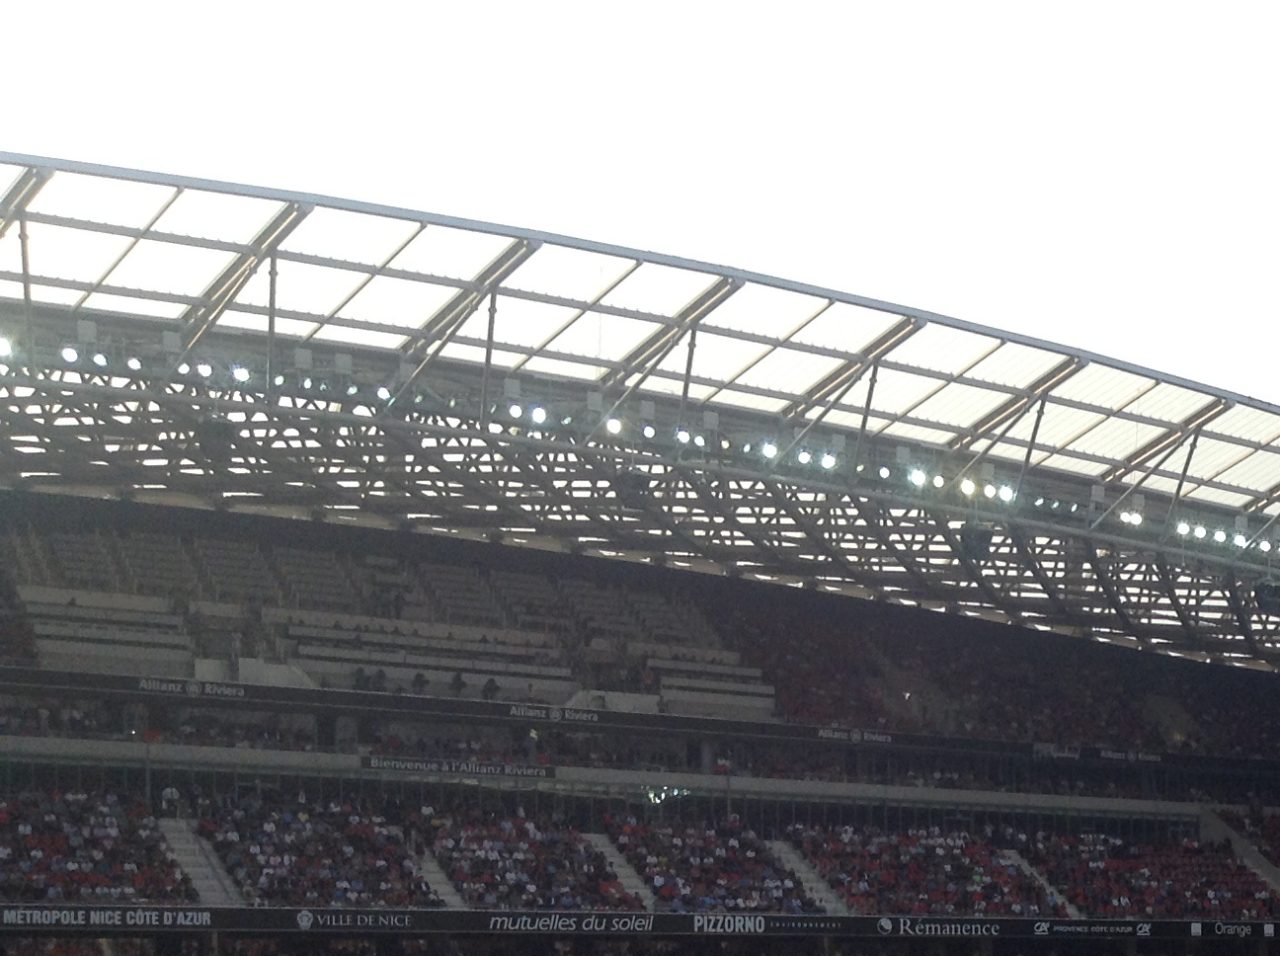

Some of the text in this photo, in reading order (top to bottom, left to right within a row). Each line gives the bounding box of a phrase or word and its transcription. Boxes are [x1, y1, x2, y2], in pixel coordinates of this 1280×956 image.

[510, 705, 599, 722] Allianz Riviera
[370, 758, 438, 771] Bienvenue
[504, 764, 546, 777] Riviera
[89, 910, 122, 925] NICE
[126, 908, 159, 926] CÔTE
[163, 911, 211, 926] D'AZUR
[316, 914, 412, 927] VILLE DE NICE
[489, 915, 654, 931] mutuelles du soleil
[694, 916, 765, 933] PIZZORNO
[900, 918, 1000, 935] Rémanence
[1215, 922, 1252, 938] Orange
